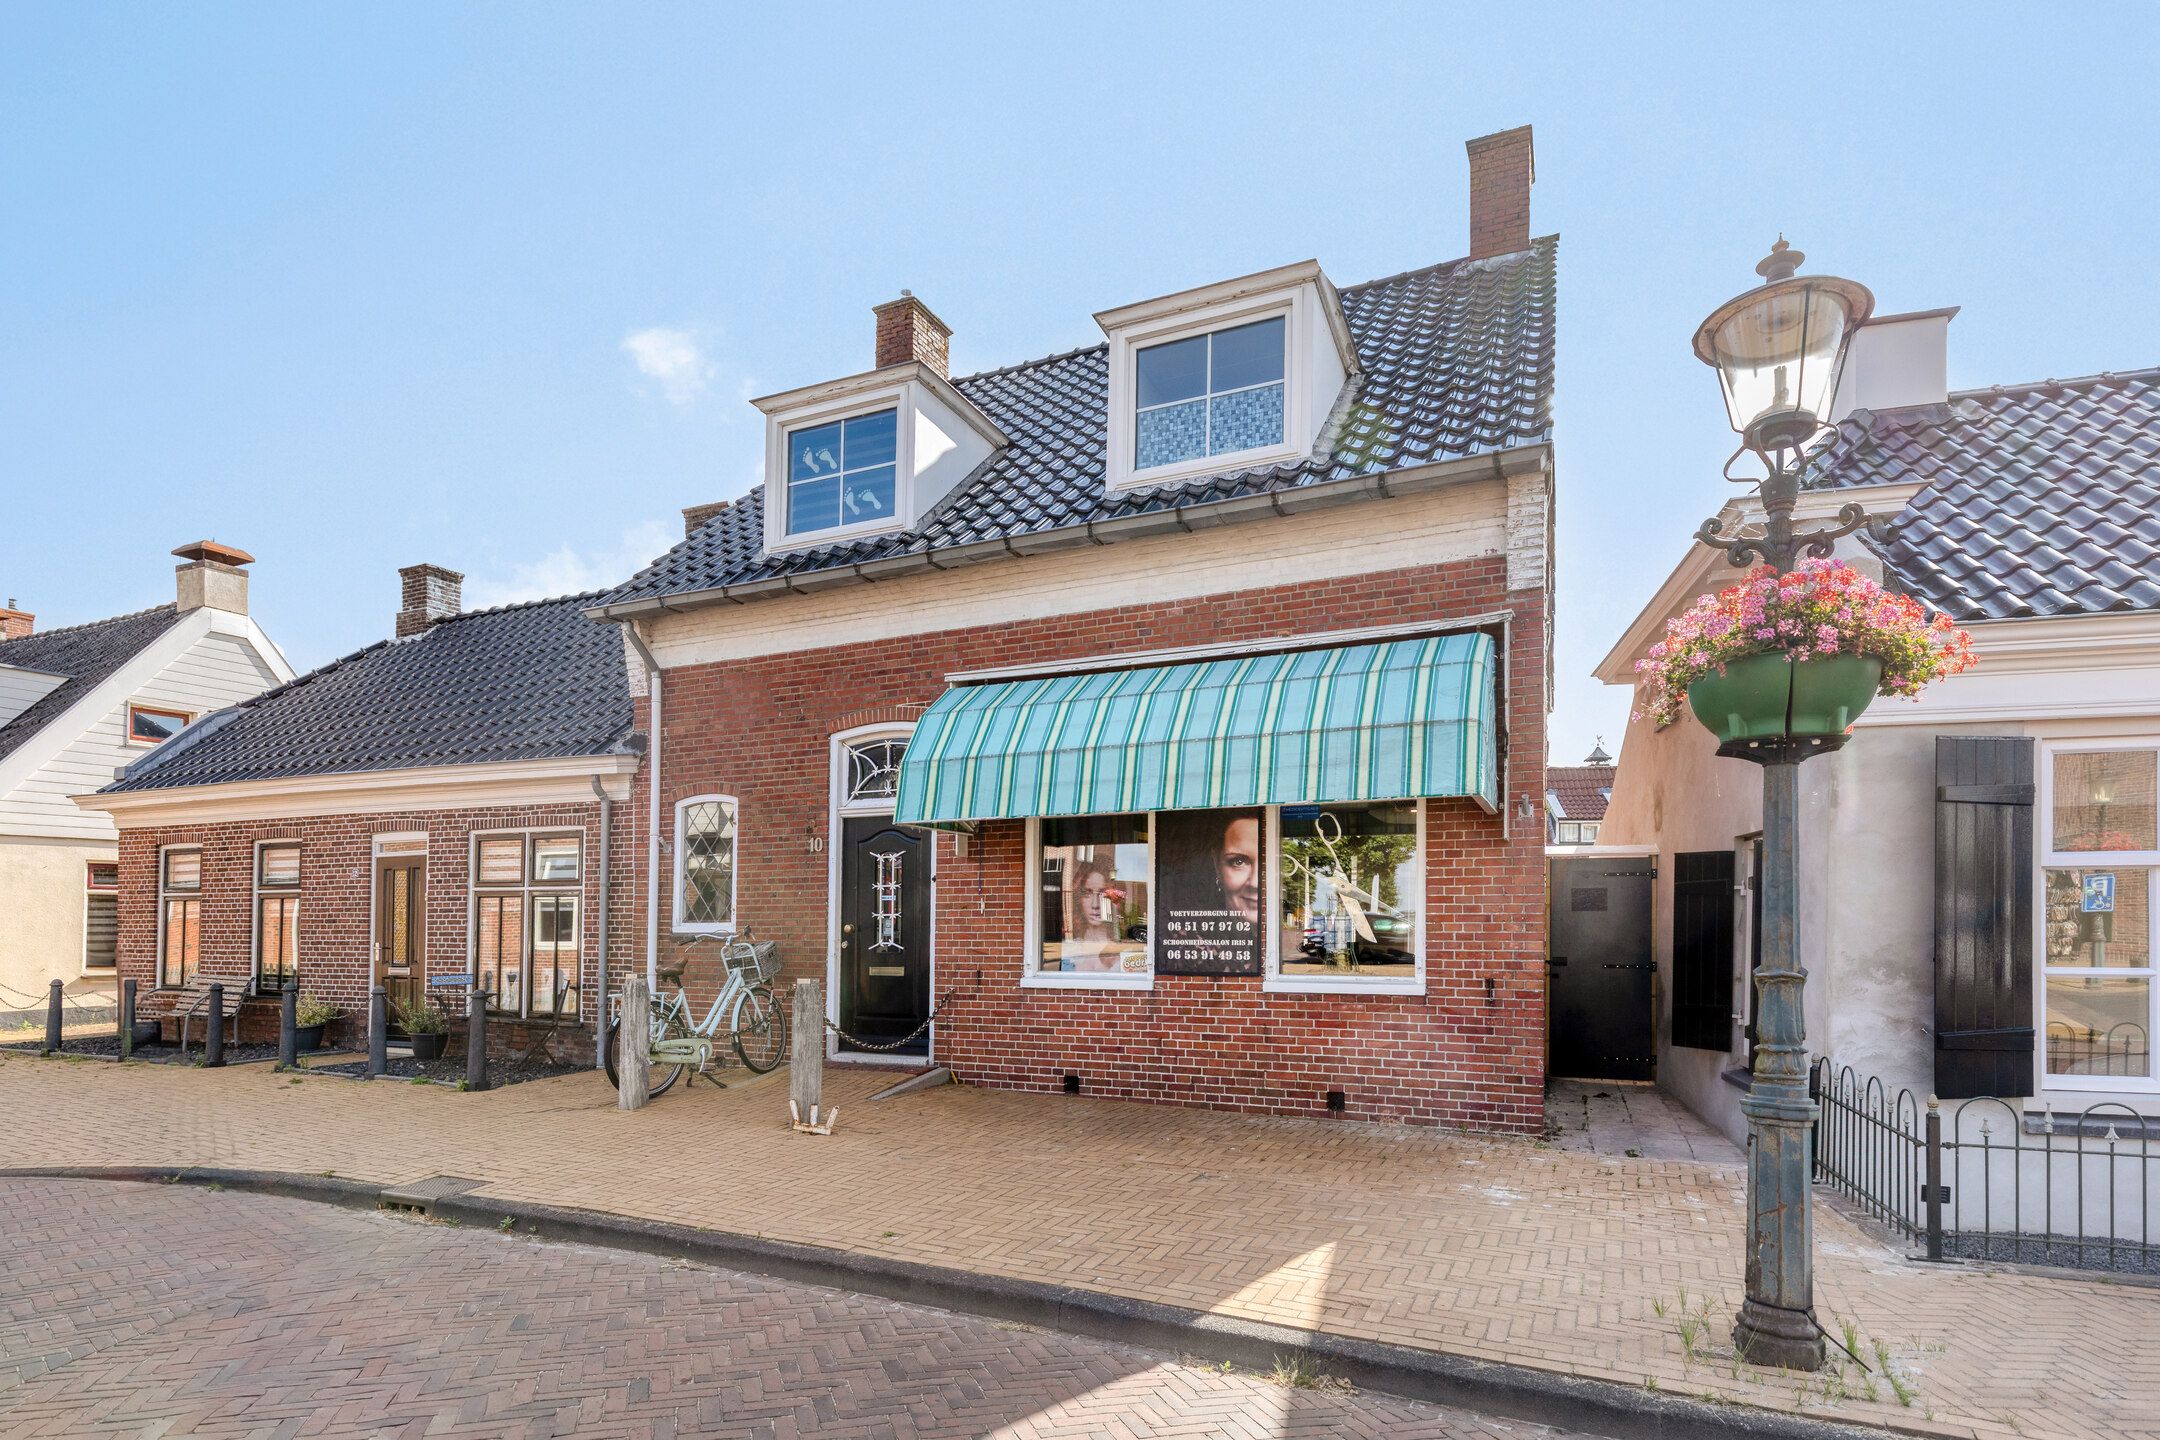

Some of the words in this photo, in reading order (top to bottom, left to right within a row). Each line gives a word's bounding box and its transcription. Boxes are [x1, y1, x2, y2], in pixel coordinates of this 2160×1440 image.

[809, 837, 823, 852] 10
[1167, 921, 1181, 931] 06
[1184, 921, 1197, 931] 51
[1201, 921, 1215, 932] 97
[1218, 921, 1232, 932] 97
[1236, 921, 1251, 932] 02
[1167, 949, 1181, 960] 06
[1184, 950, 1198, 960] 53
[1201, 950, 1214, 960] 91
[1218, 950, 1232, 961] 49
[1236, 950, 1251, 961] 58
